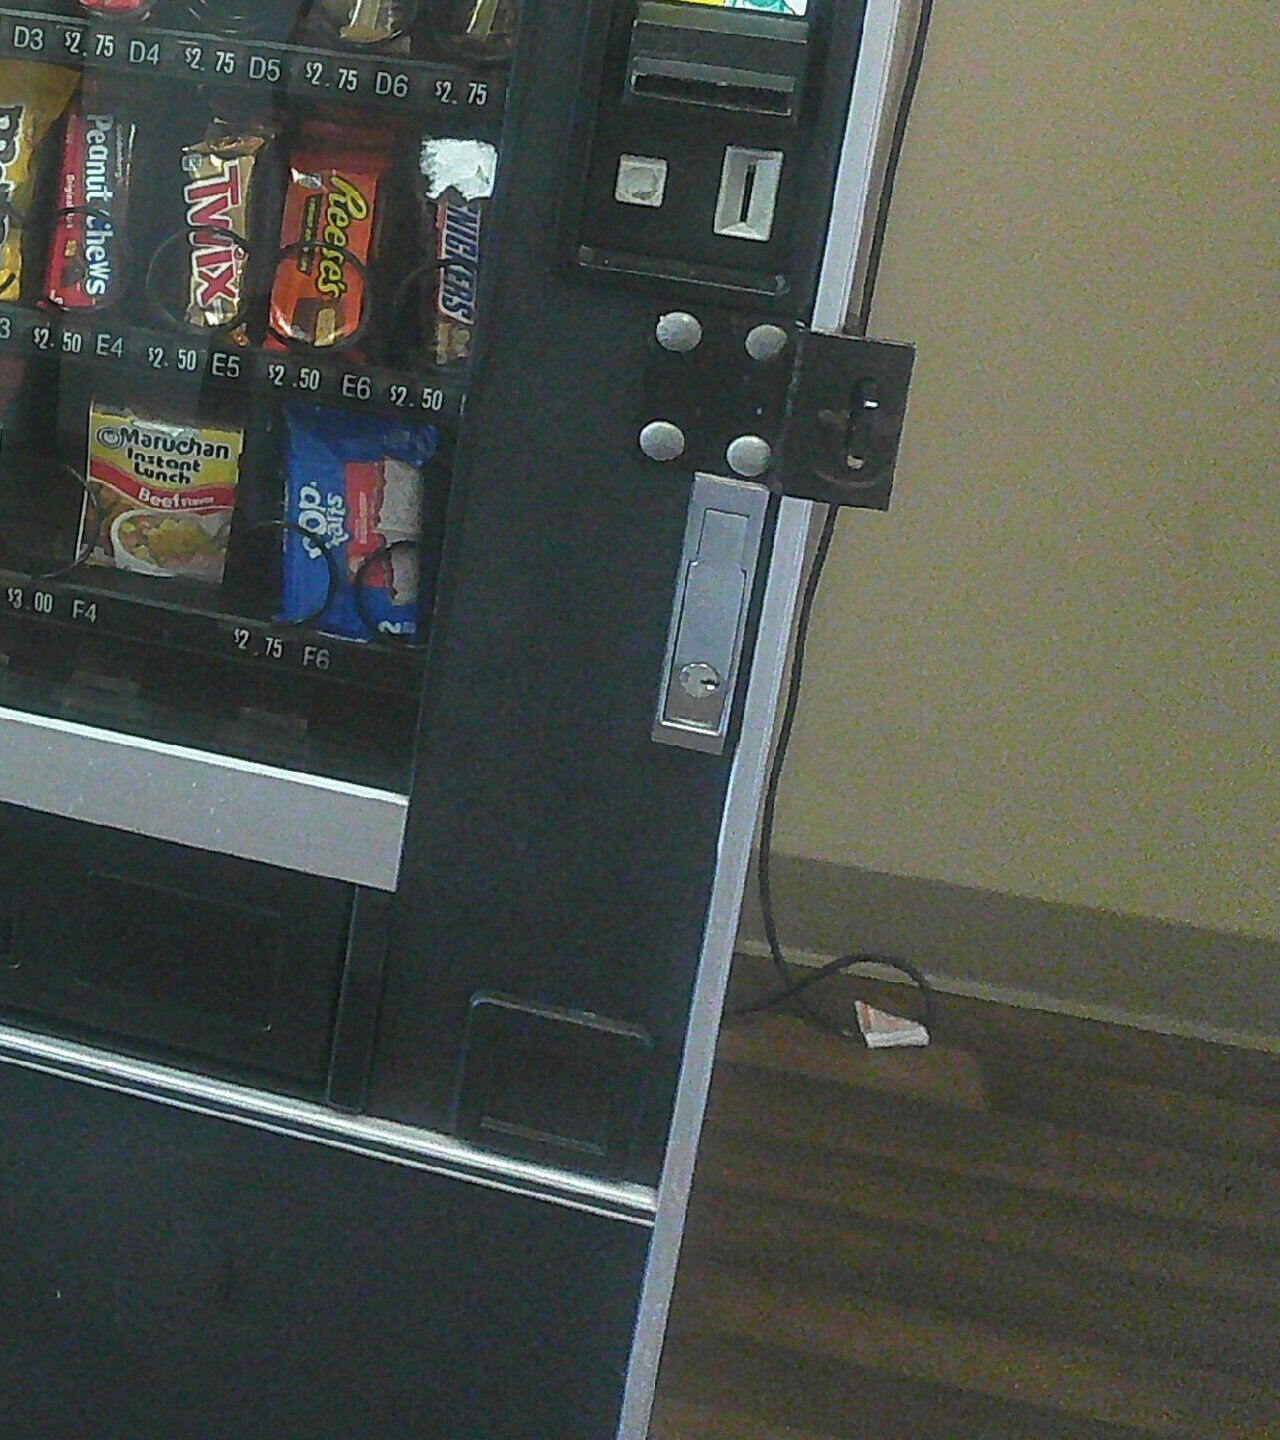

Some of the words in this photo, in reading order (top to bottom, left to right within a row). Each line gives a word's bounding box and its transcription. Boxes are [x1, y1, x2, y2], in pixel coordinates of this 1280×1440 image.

[13, 25, 44, 51] D3
[128, 40, 161, 66] D4
[248, 55, 282, 82] D5
[373, 71, 410, 99] D6
[83, 113, 115, 204] Peanut
[95, 333, 124, 359] E4
[211, 352, 240, 379] E5
[342, 376, 372, 401] E6
[121, 425, 230, 461] Maruchan
[126, 447, 202, 473] Instant
[133, 463, 192, 485] Lunch
[138, 487, 180, 509] Beef
[72, 598, 98, 624] F4
[302, 645, 332, 671] F6
